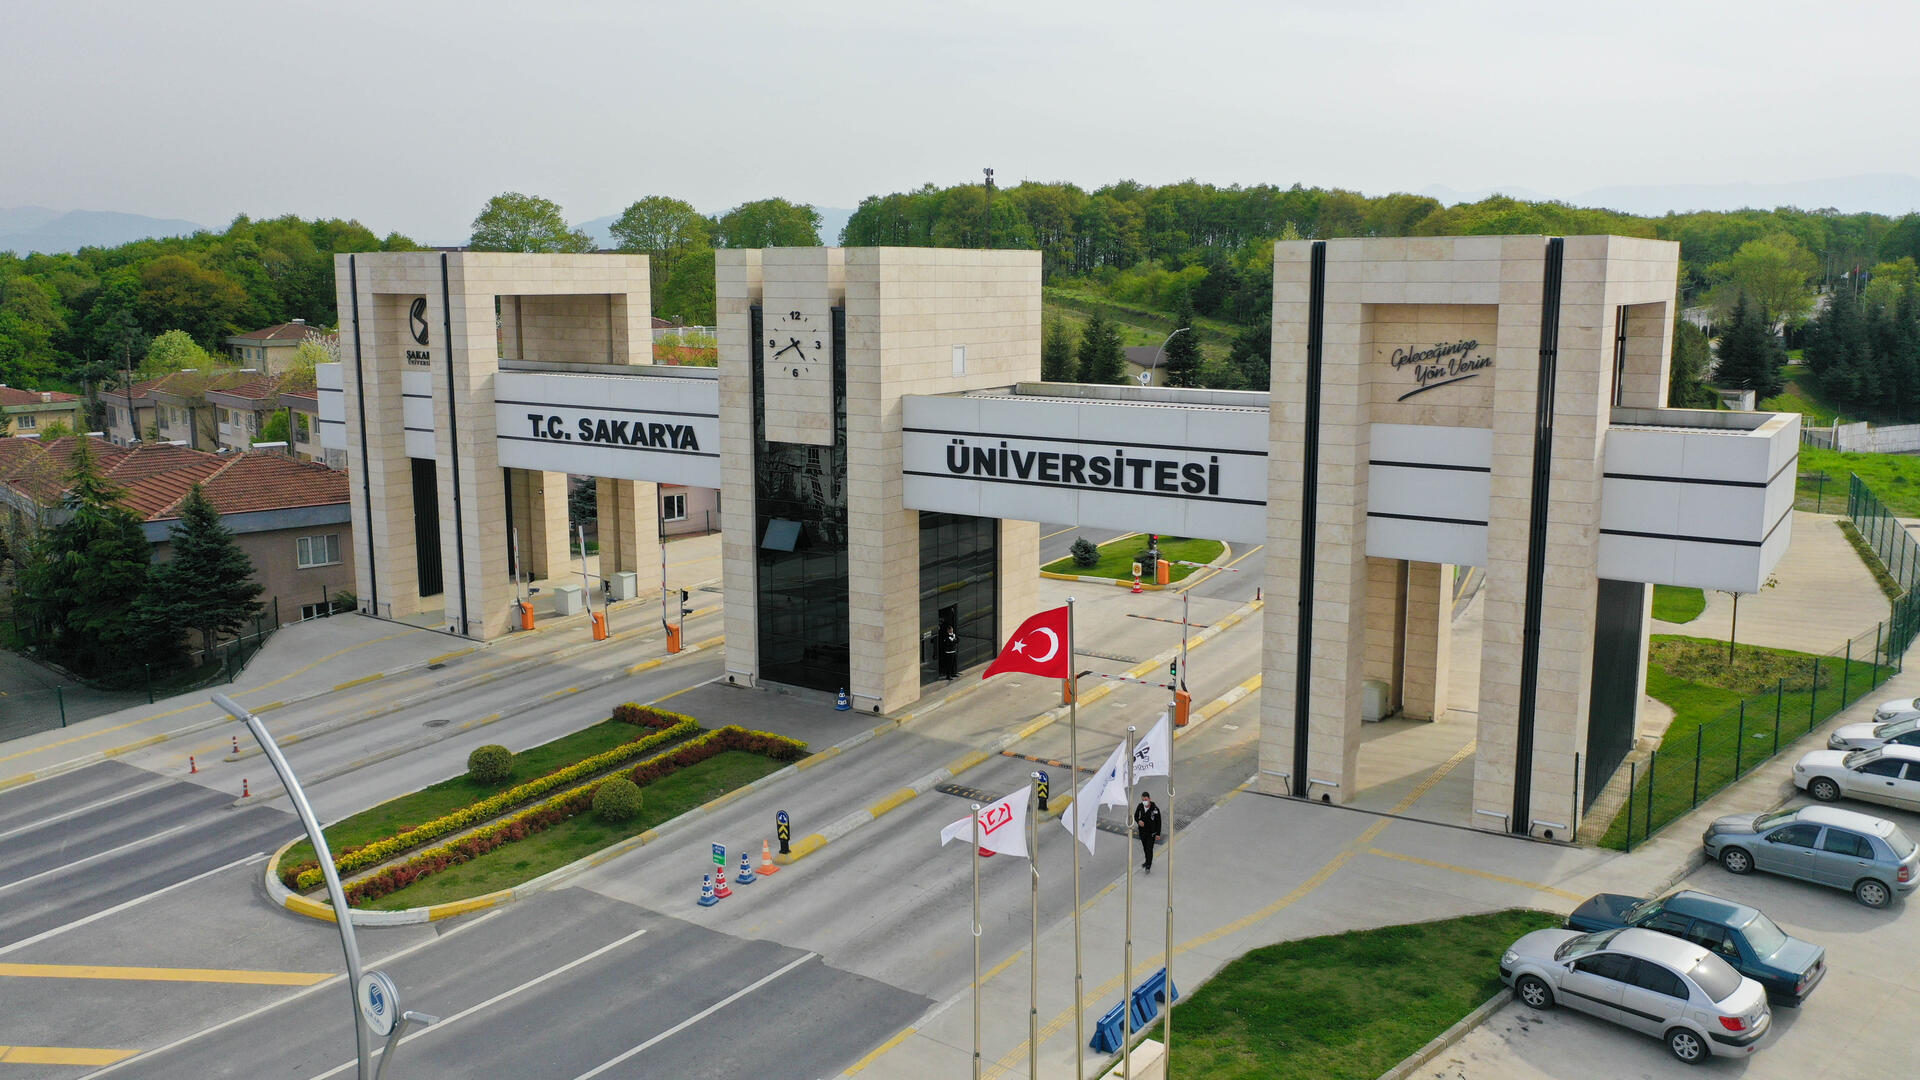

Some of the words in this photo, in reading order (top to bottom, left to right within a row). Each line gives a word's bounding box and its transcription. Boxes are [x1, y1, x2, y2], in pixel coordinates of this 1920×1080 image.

[789, 311, 801, 321] 12
[769, 339, 776, 348] 9
[815, 340, 821, 350] 3
[792, 368, 799, 378] 6
[1414, 364, 1446, 386] Yön
[1448, 354, 1493, 376] Verin
[527, 413, 571, 440] T.C.
[578, 417, 700, 450] SAKARYA
[946, 438, 1220, 496] ÜNİVERSİTESİ
